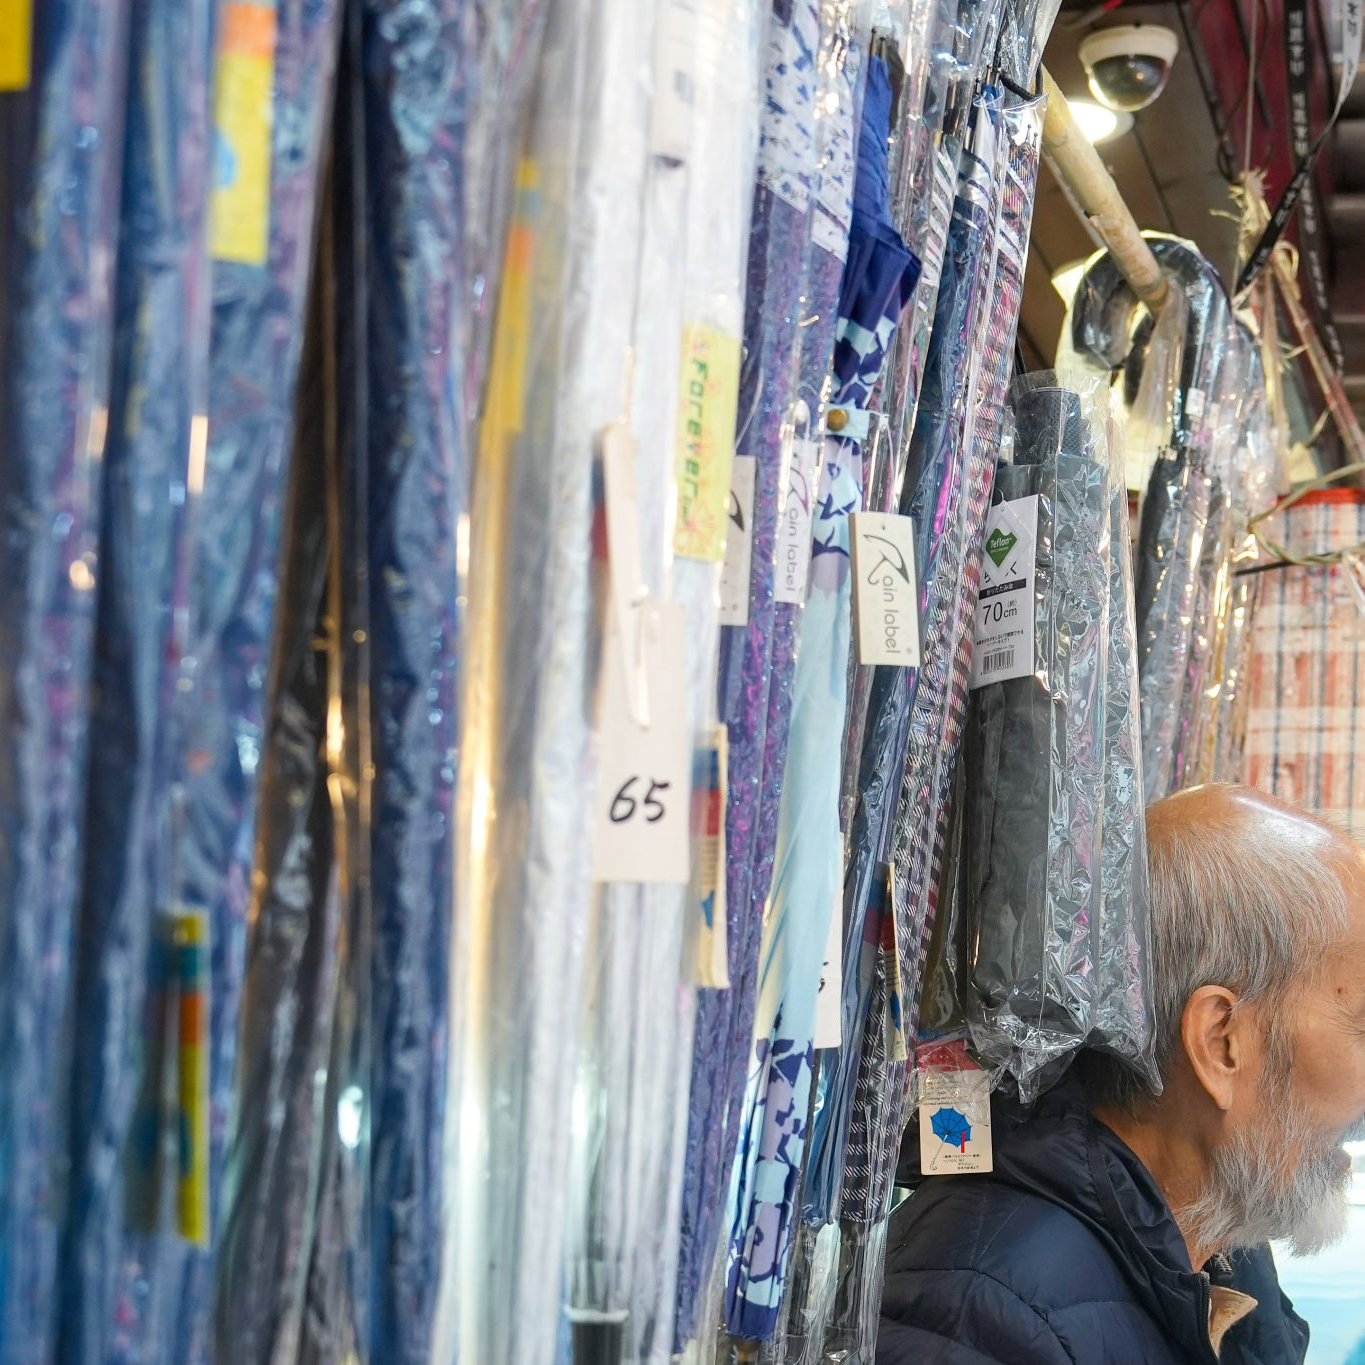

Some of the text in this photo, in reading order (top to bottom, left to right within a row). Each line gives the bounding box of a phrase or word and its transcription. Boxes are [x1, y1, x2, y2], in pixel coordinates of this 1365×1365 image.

[786, 543, 798, 591] label
[884, 608, 901, 654] label
[609, 776, 670, 823] 65
